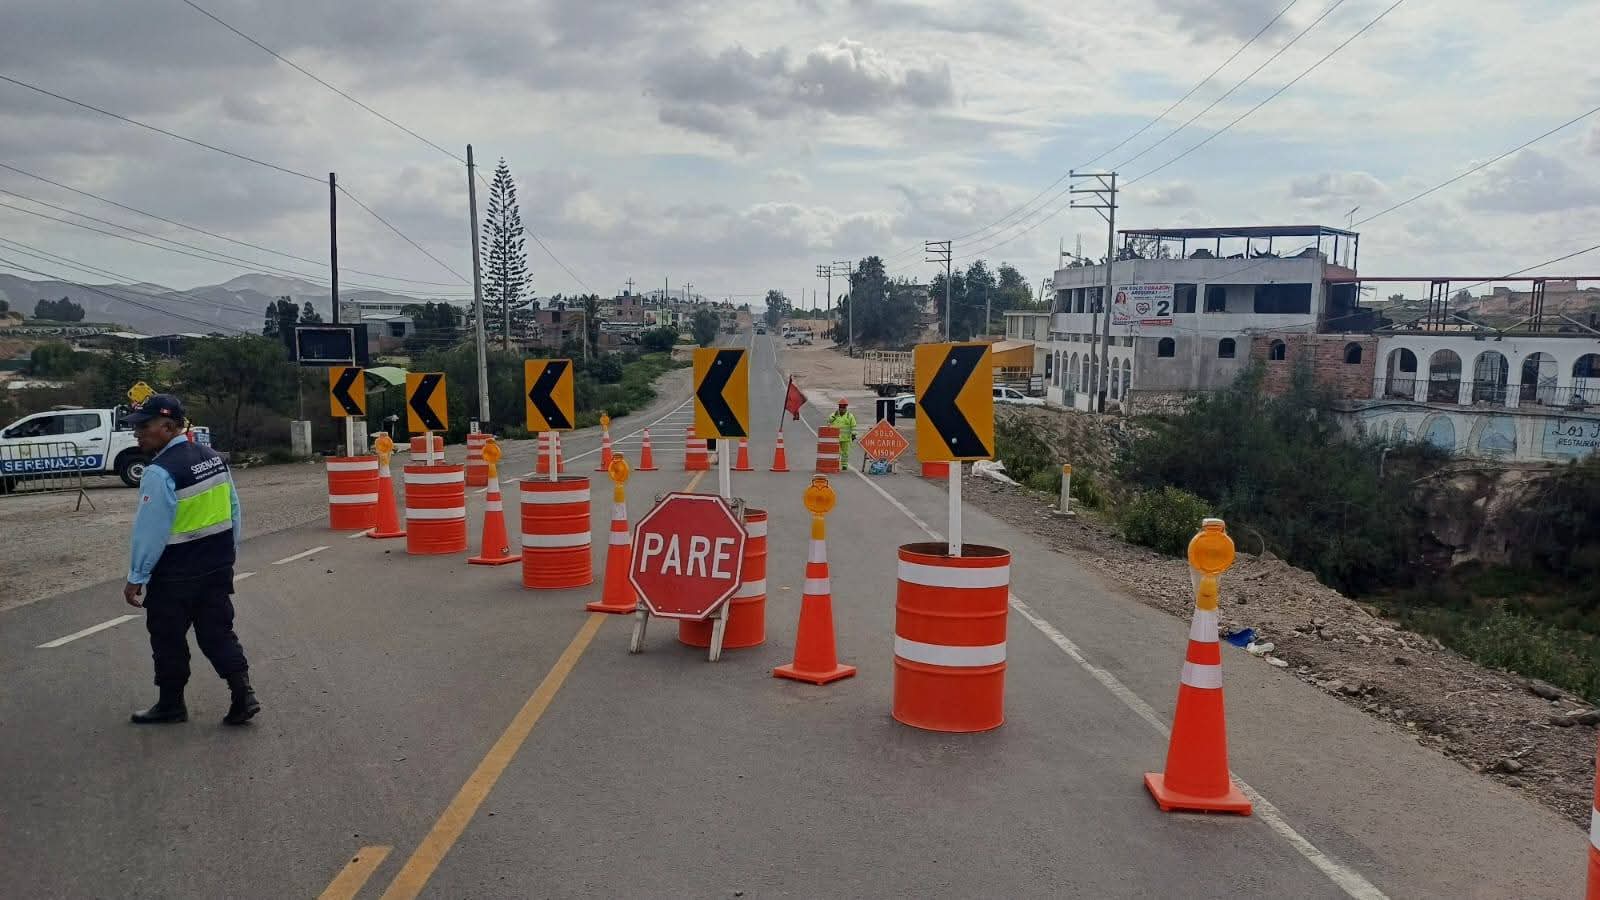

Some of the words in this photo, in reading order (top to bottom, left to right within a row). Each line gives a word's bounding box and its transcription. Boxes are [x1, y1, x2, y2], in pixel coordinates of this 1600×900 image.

[1156, 300, 1170, 317] 2
[1552, 418, 1583, 437] Los
[4, 456, 97, 472] SERENAZGO
[639, 532, 735, 579] PARE
